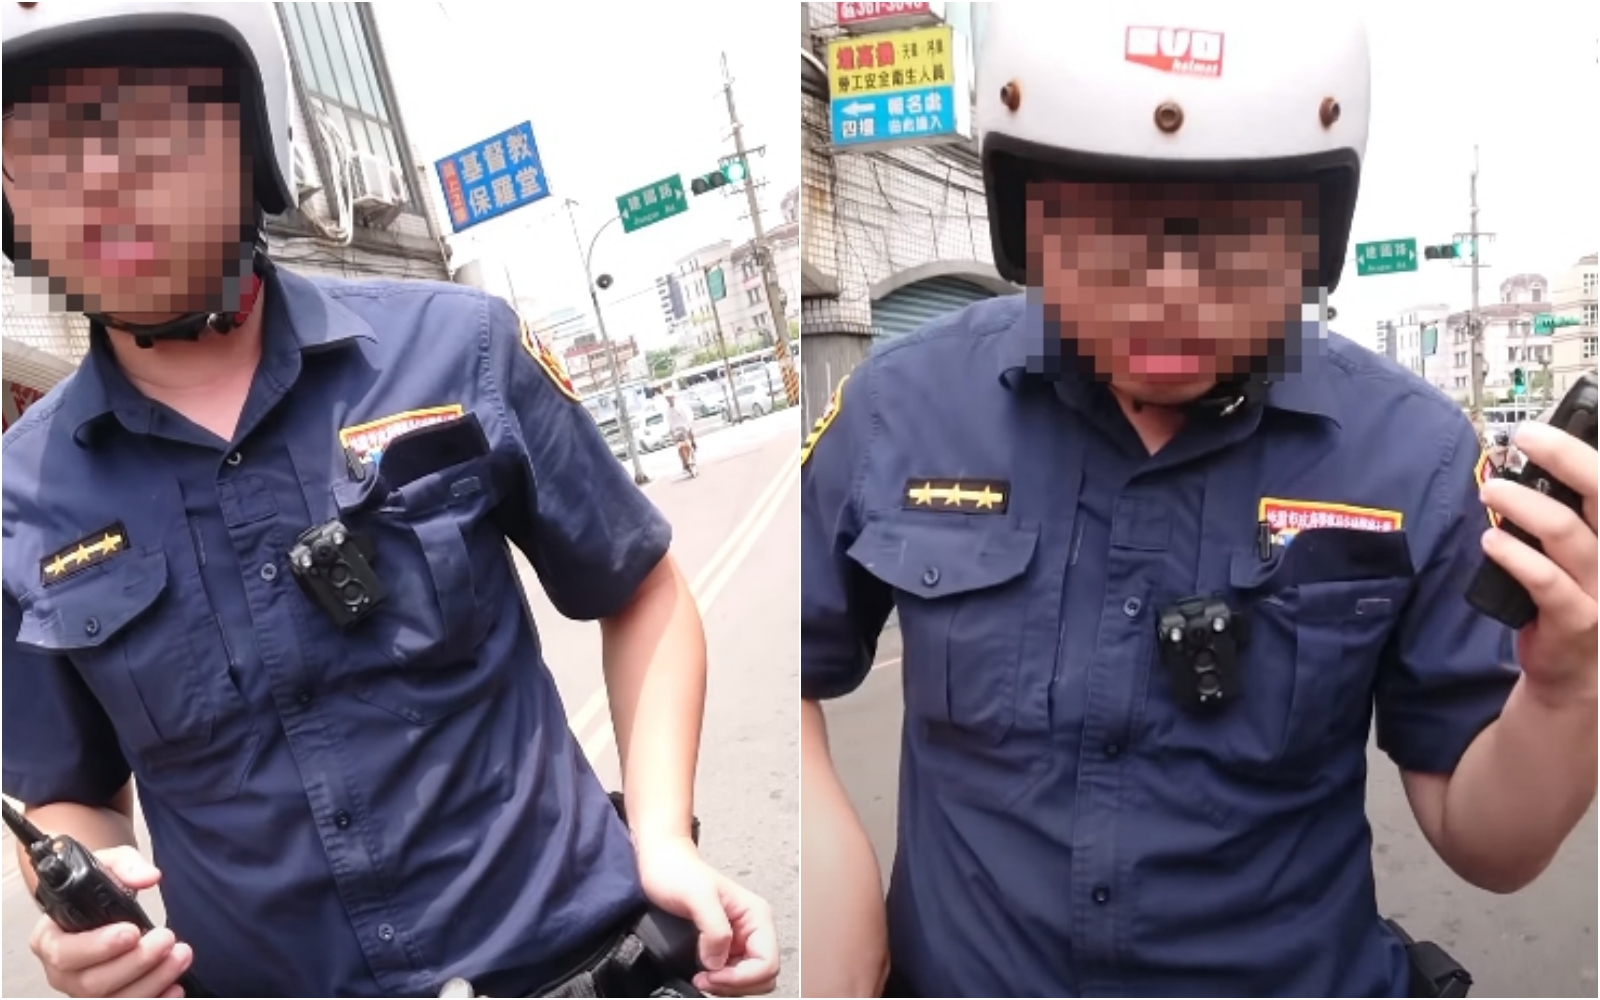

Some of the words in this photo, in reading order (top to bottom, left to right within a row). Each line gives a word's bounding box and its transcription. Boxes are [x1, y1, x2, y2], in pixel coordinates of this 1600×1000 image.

[836, 41, 895, 70] 堆高機
[838, 64, 945, 93] 勞工安全衛生人員
[888, 92, 942, 116] 報名處
[459, 135, 532, 183] 基督教
[469, 167, 541, 216] 保羅堂
[628, 184, 673, 211] 建國路
[1366, 243, 1406, 258] 建國路
